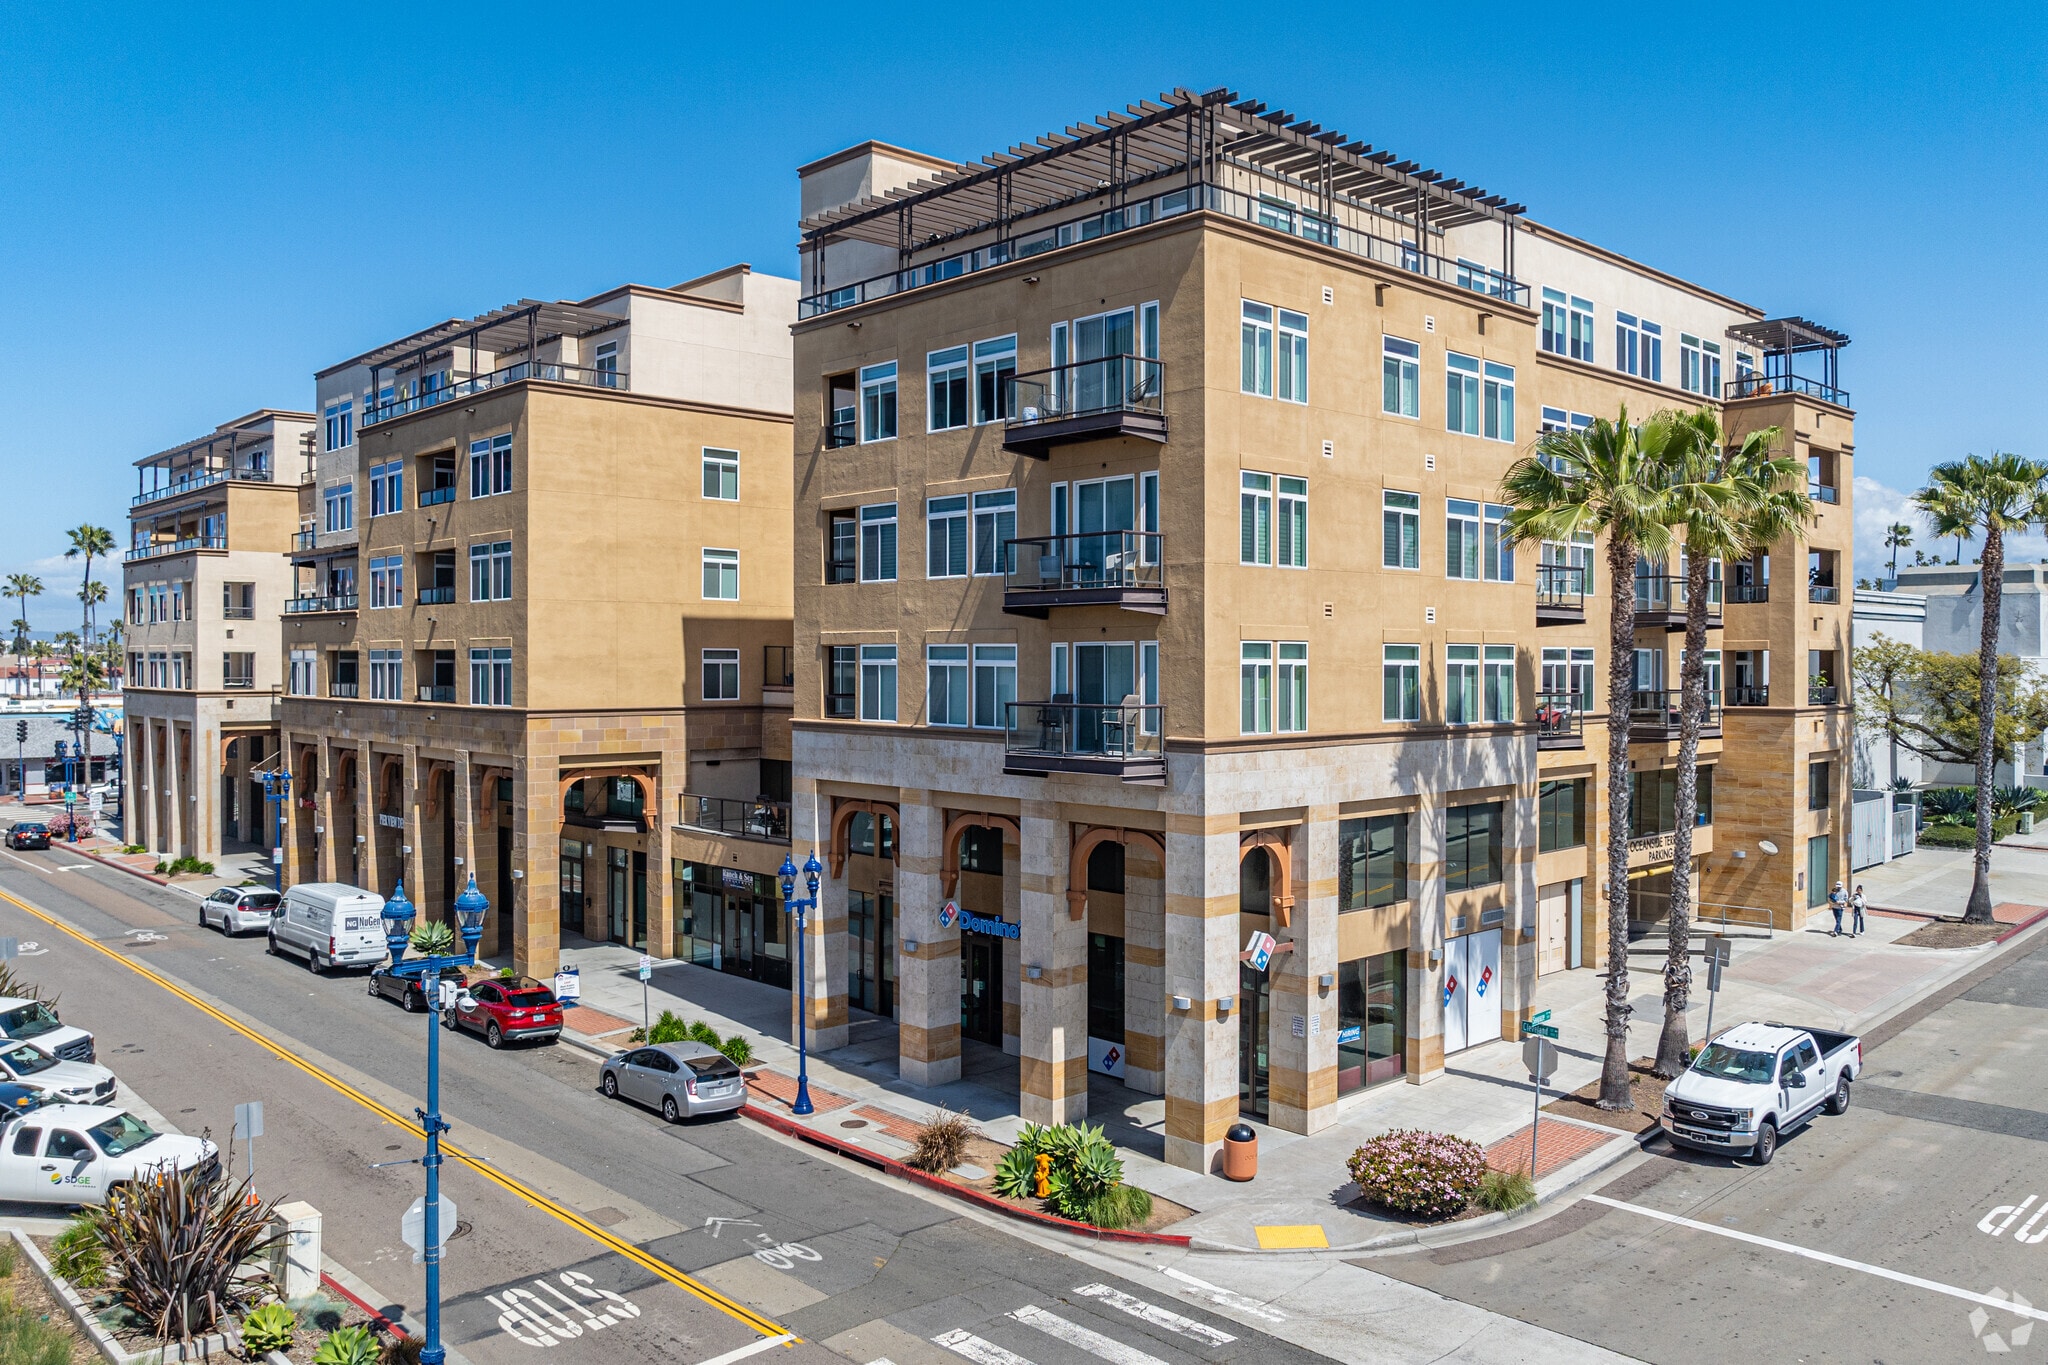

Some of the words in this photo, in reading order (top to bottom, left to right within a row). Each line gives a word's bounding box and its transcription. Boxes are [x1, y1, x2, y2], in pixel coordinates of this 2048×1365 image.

[379, 814, 388, 827] PIER
[388, 815, 398, 828] VIEW
[1630, 837, 1663, 852] OCEANSIDE
[1649, 848, 1673, 862] PARKING
[346, 920, 357, 928] NG
[360, 916, 380, 927] NuGen
[959, 910, 1021, 939] Domino'
[1523, 1022, 1549, 1036] Cleveland
[64, 1175, 91, 1185] SDGE
[485, 1271, 641, 1347] STOP
